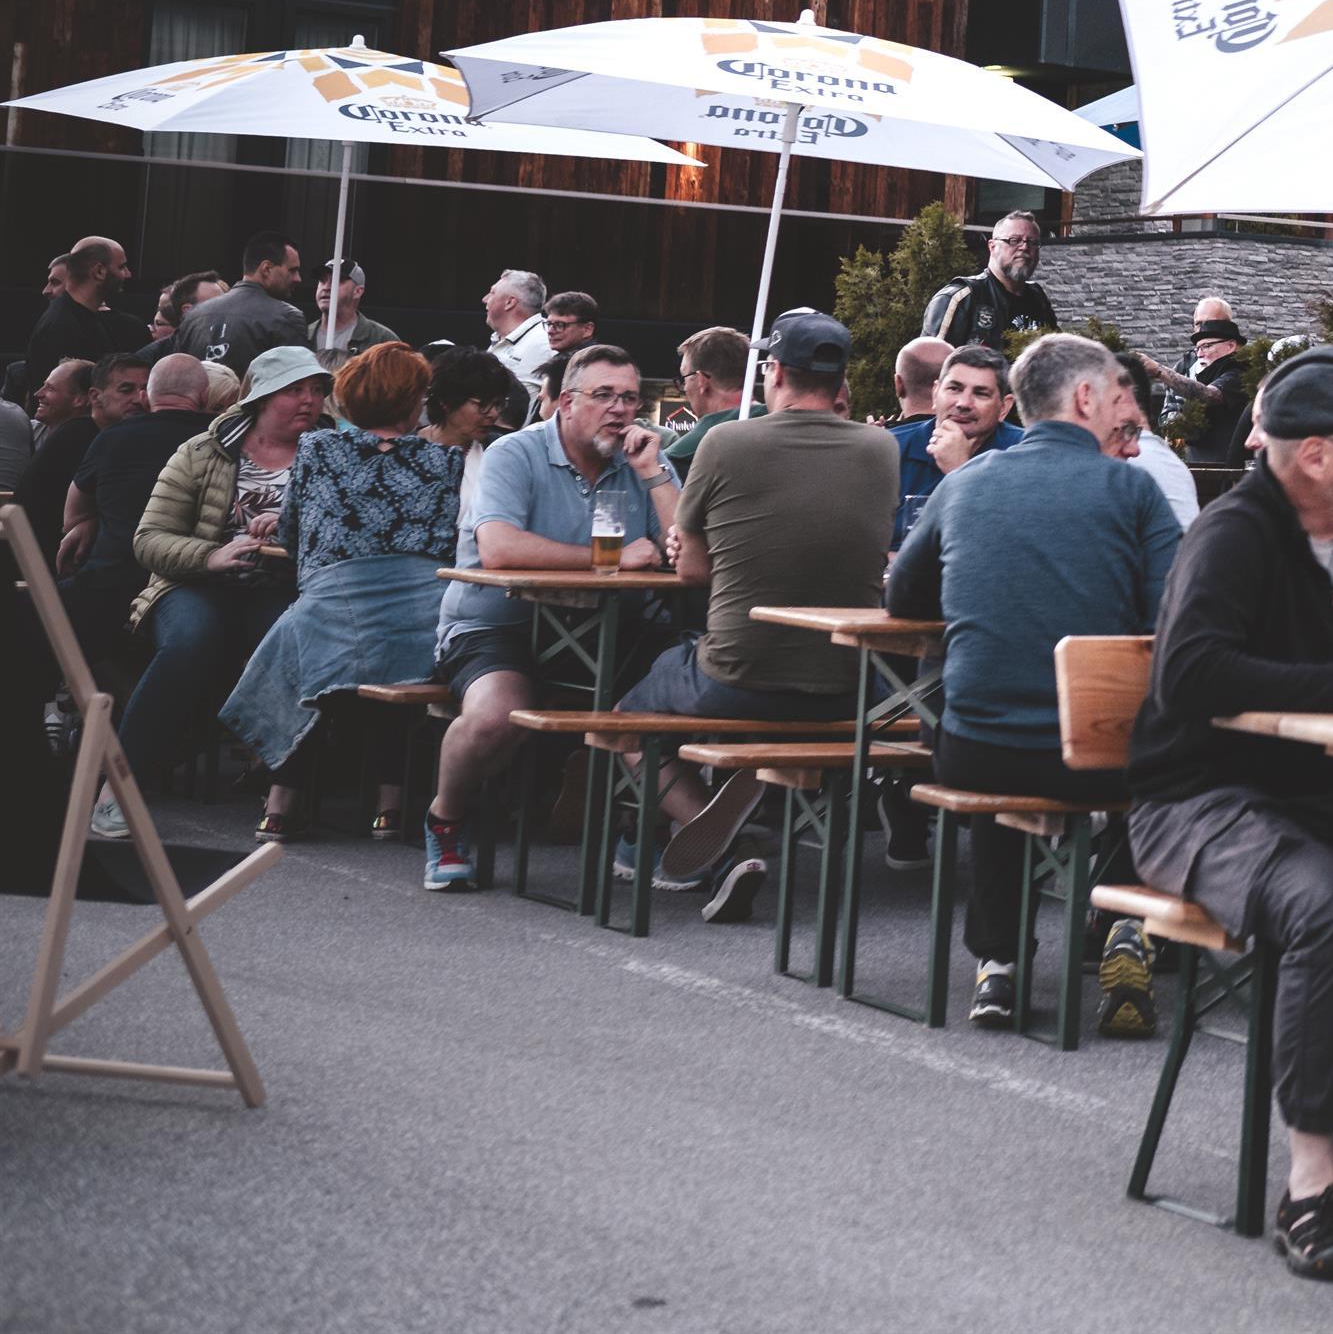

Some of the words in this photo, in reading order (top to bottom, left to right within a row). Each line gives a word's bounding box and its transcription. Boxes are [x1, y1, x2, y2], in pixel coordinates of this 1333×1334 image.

[716, 59, 898, 95] Corona
[770, 78, 865, 102] Extra
[338, 103, 487, 128] Corona
[386, 121, 469, 138] Extra
